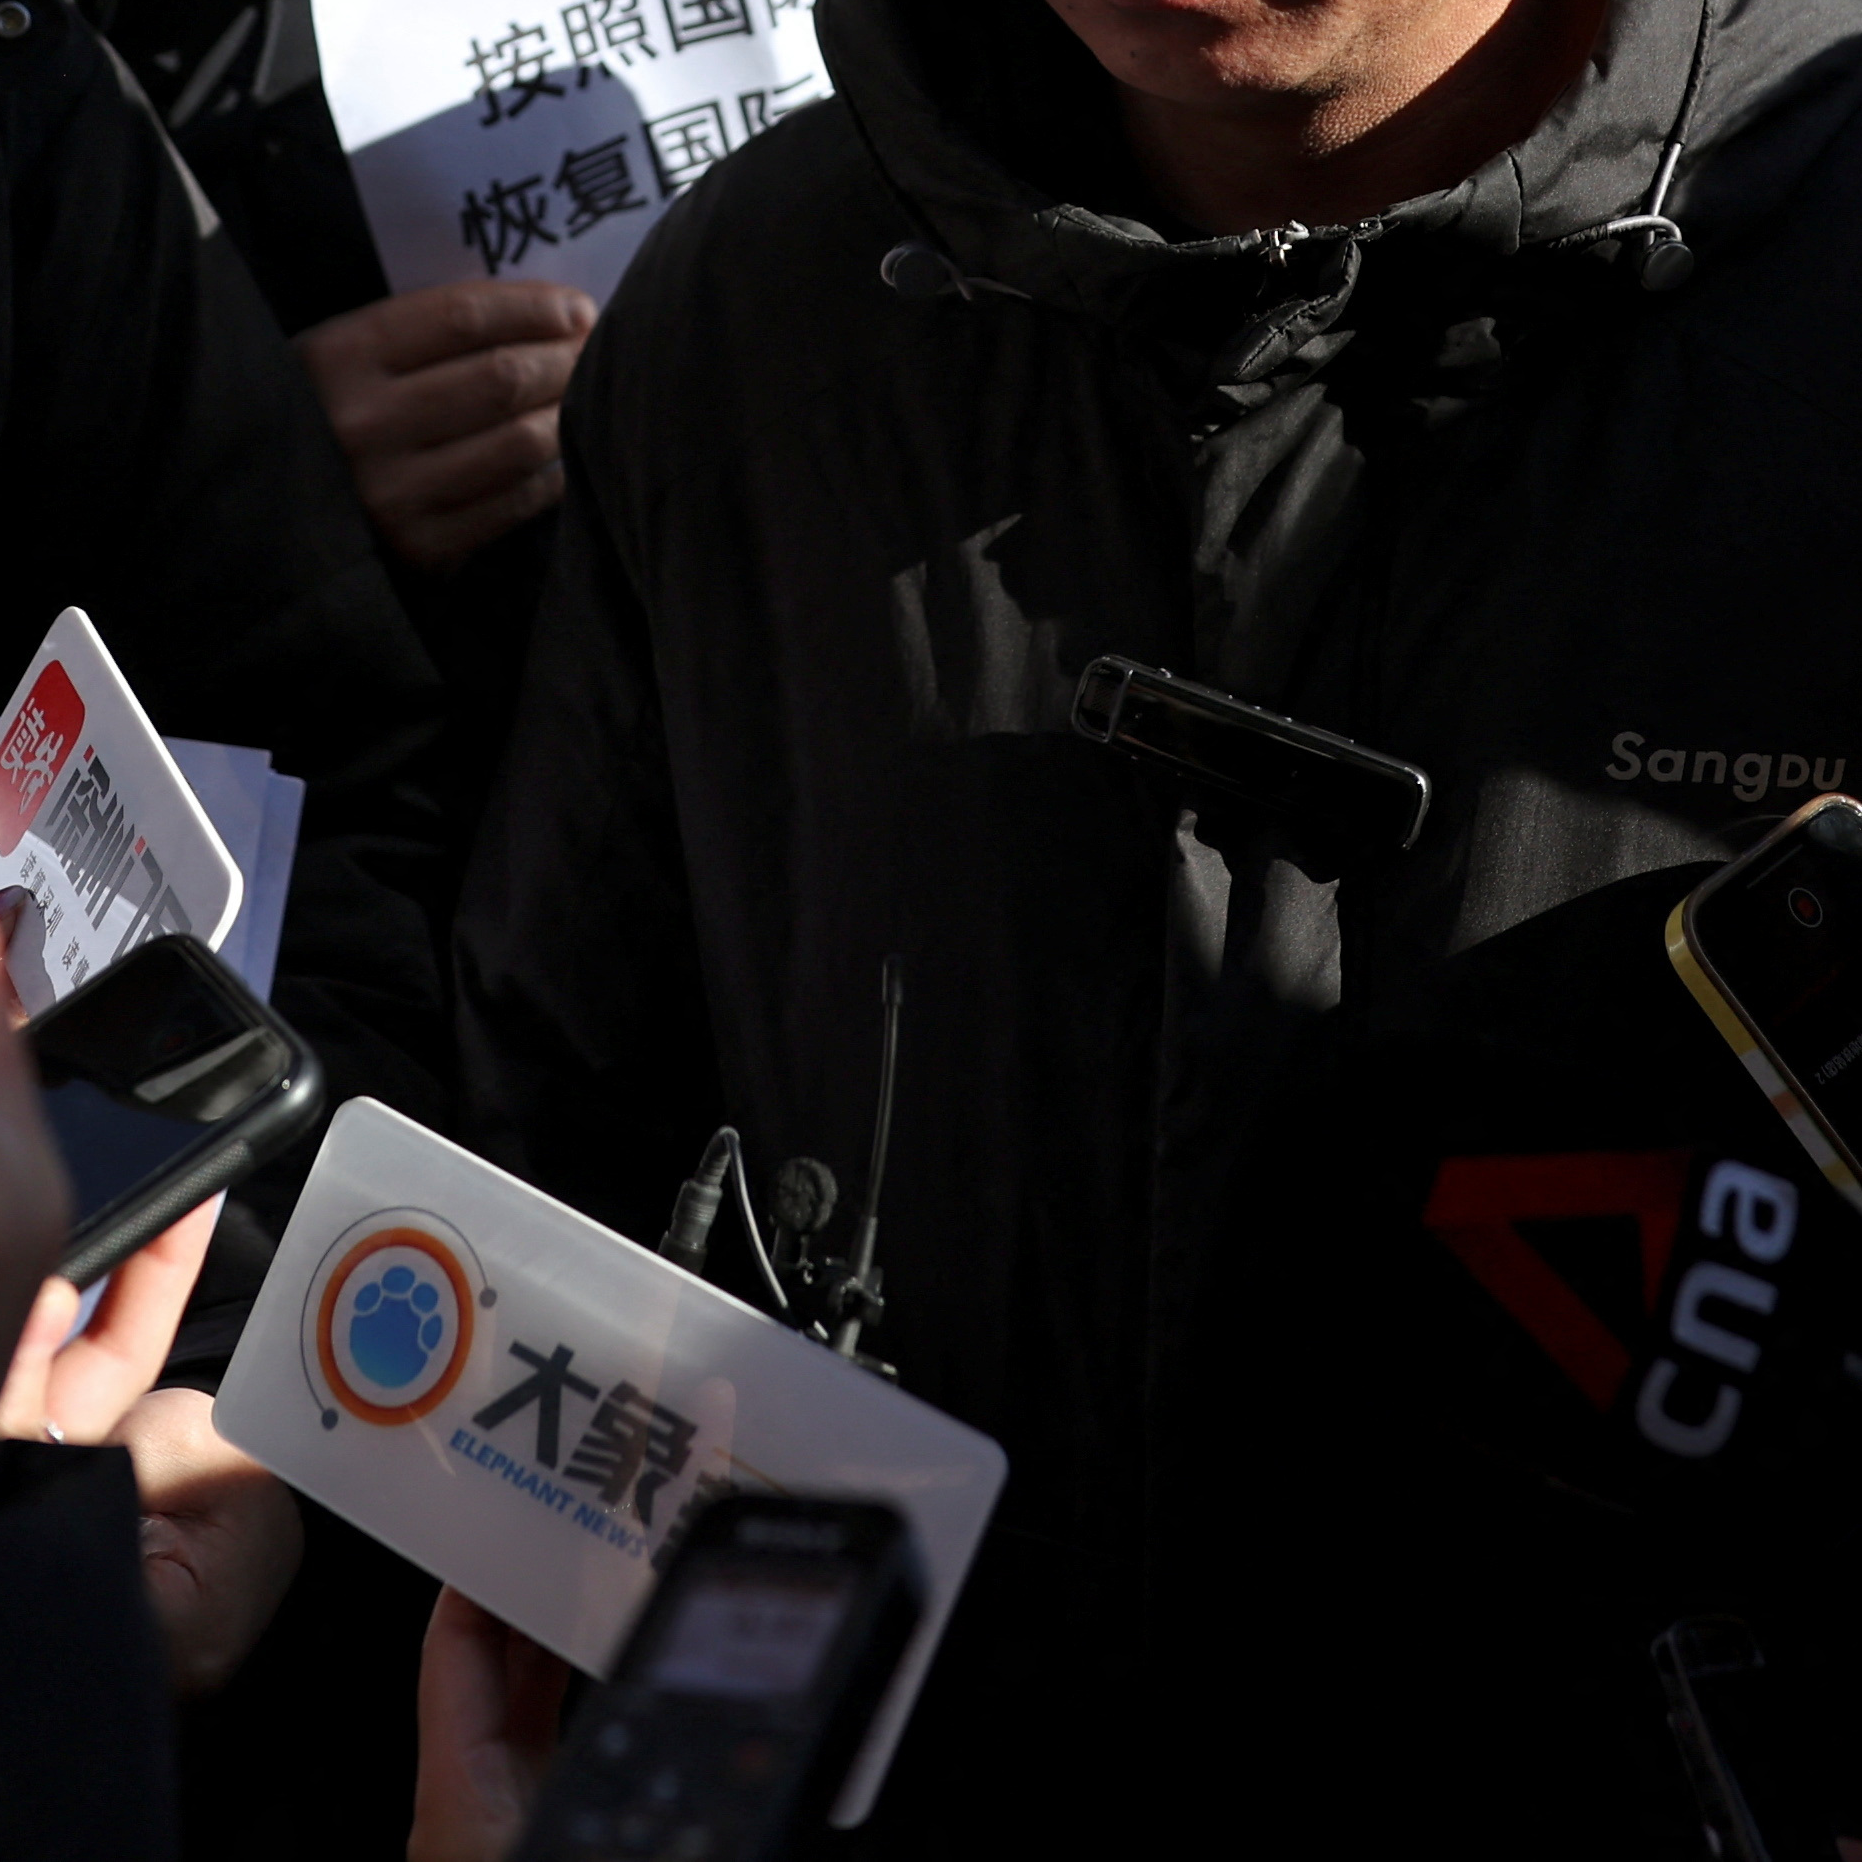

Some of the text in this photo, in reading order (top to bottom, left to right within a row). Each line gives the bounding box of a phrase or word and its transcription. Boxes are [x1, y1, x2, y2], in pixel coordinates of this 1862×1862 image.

[1636, 1159, 1799, 1458] cna
[449, 1428, 645, 1559] ELEPHANT NEWS
